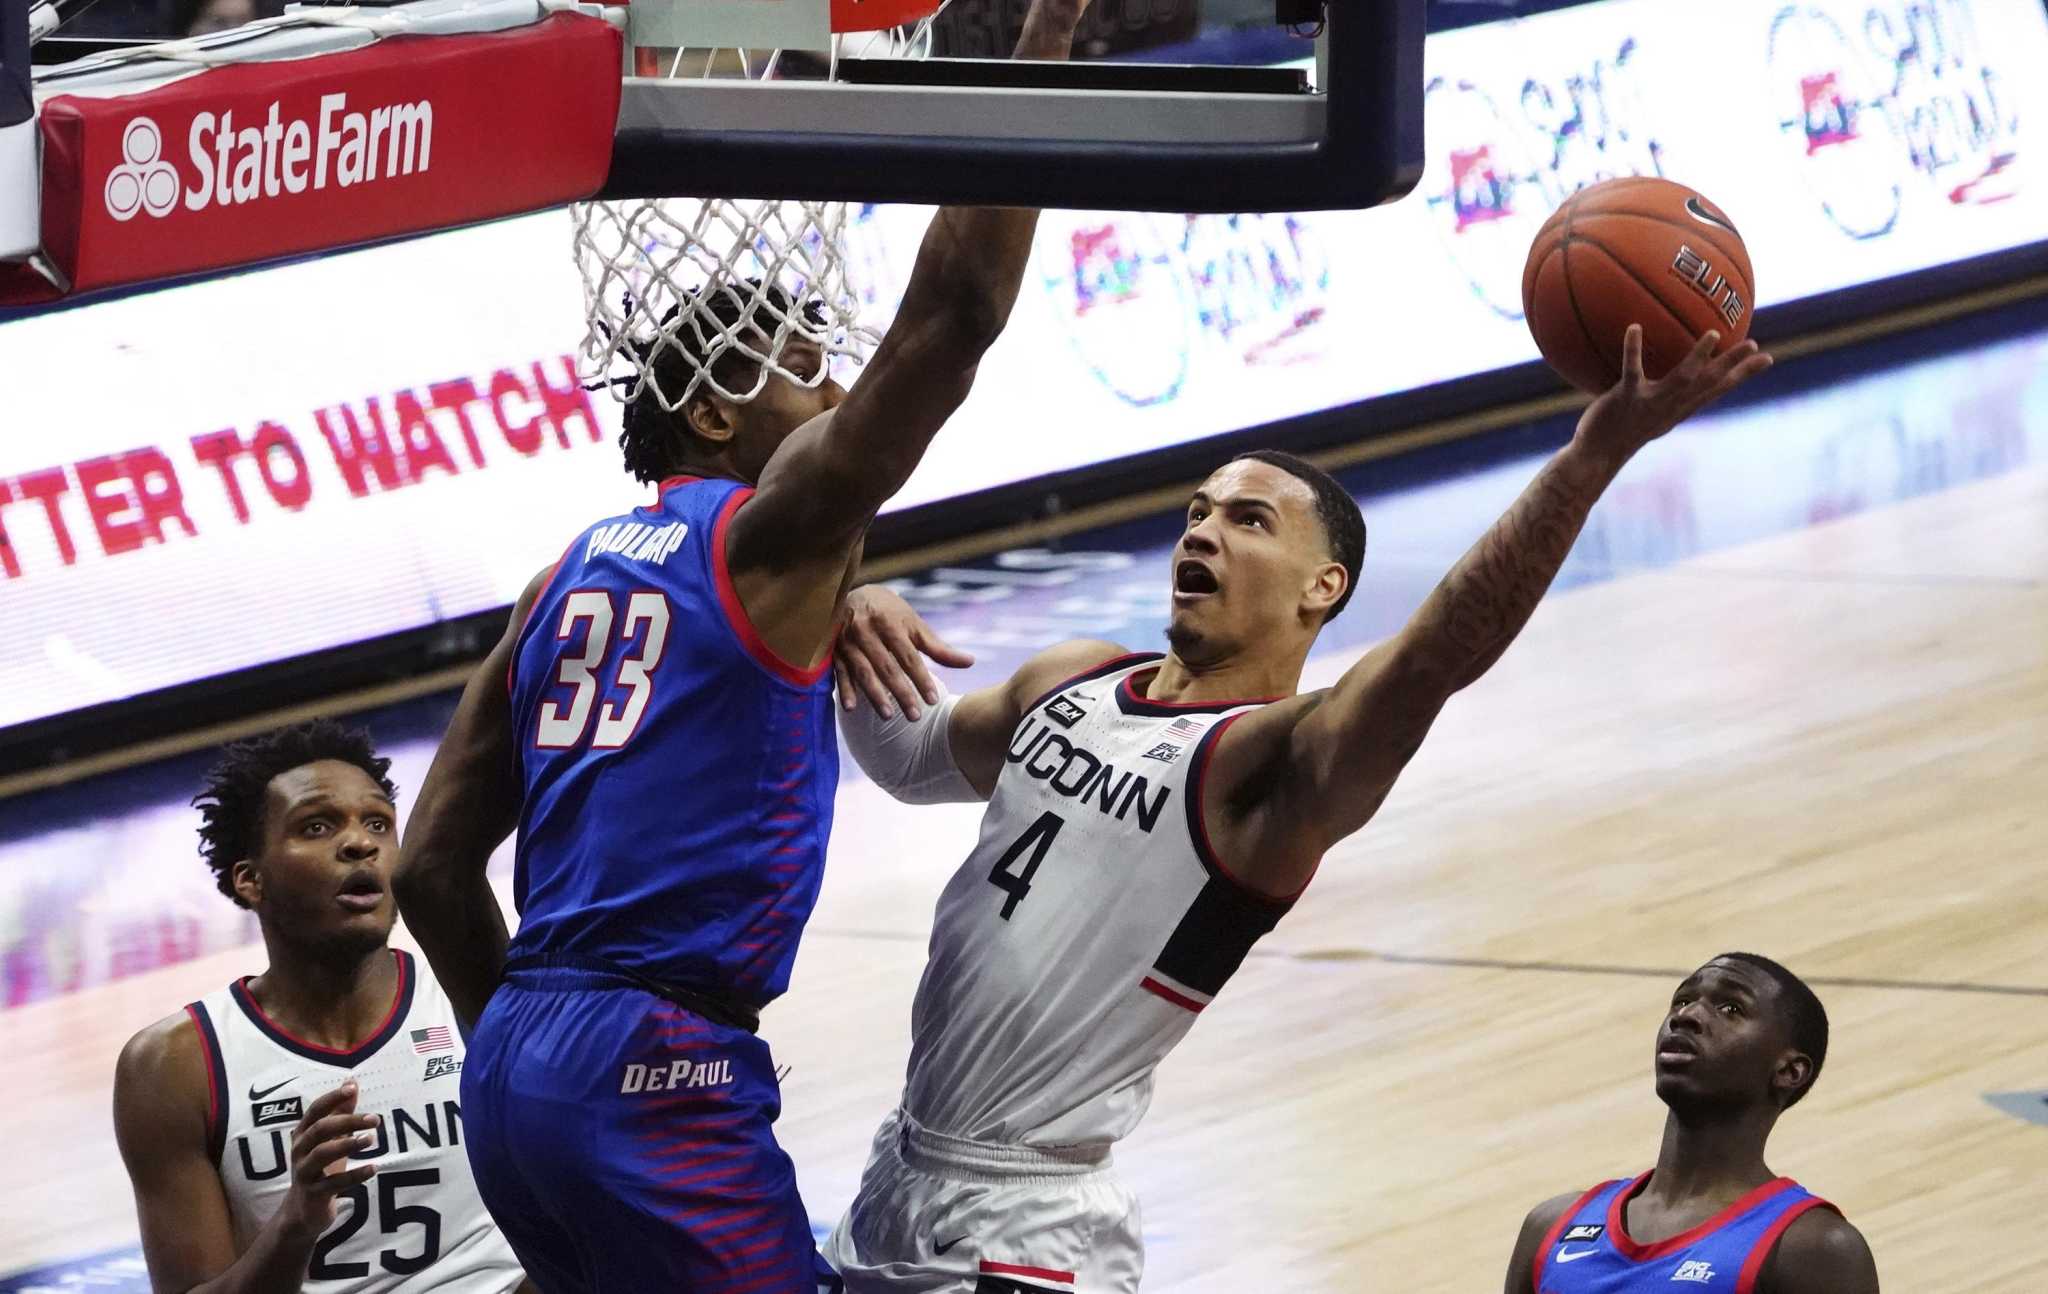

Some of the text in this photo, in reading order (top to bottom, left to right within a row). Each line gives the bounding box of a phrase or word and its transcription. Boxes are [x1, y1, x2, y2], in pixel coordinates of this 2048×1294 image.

[1672, 244, 1744, 329] ELITE
[190, 420, 312, 524] TO
[313, 354, 602, 498] WATCH
[535, 588, 671, 748] 33
[1006, 717, 1171, 833] UCONN
[1147, 748, 1181, 761] EAST
[987, 810, 1065, 921] 4
[260, 1101, 298, 1116] BLM
[425, 1061, 463, 1076] EAST
[427, 1055, 454, 1068] BIG
[308, 1167, 441, 1280] 25
